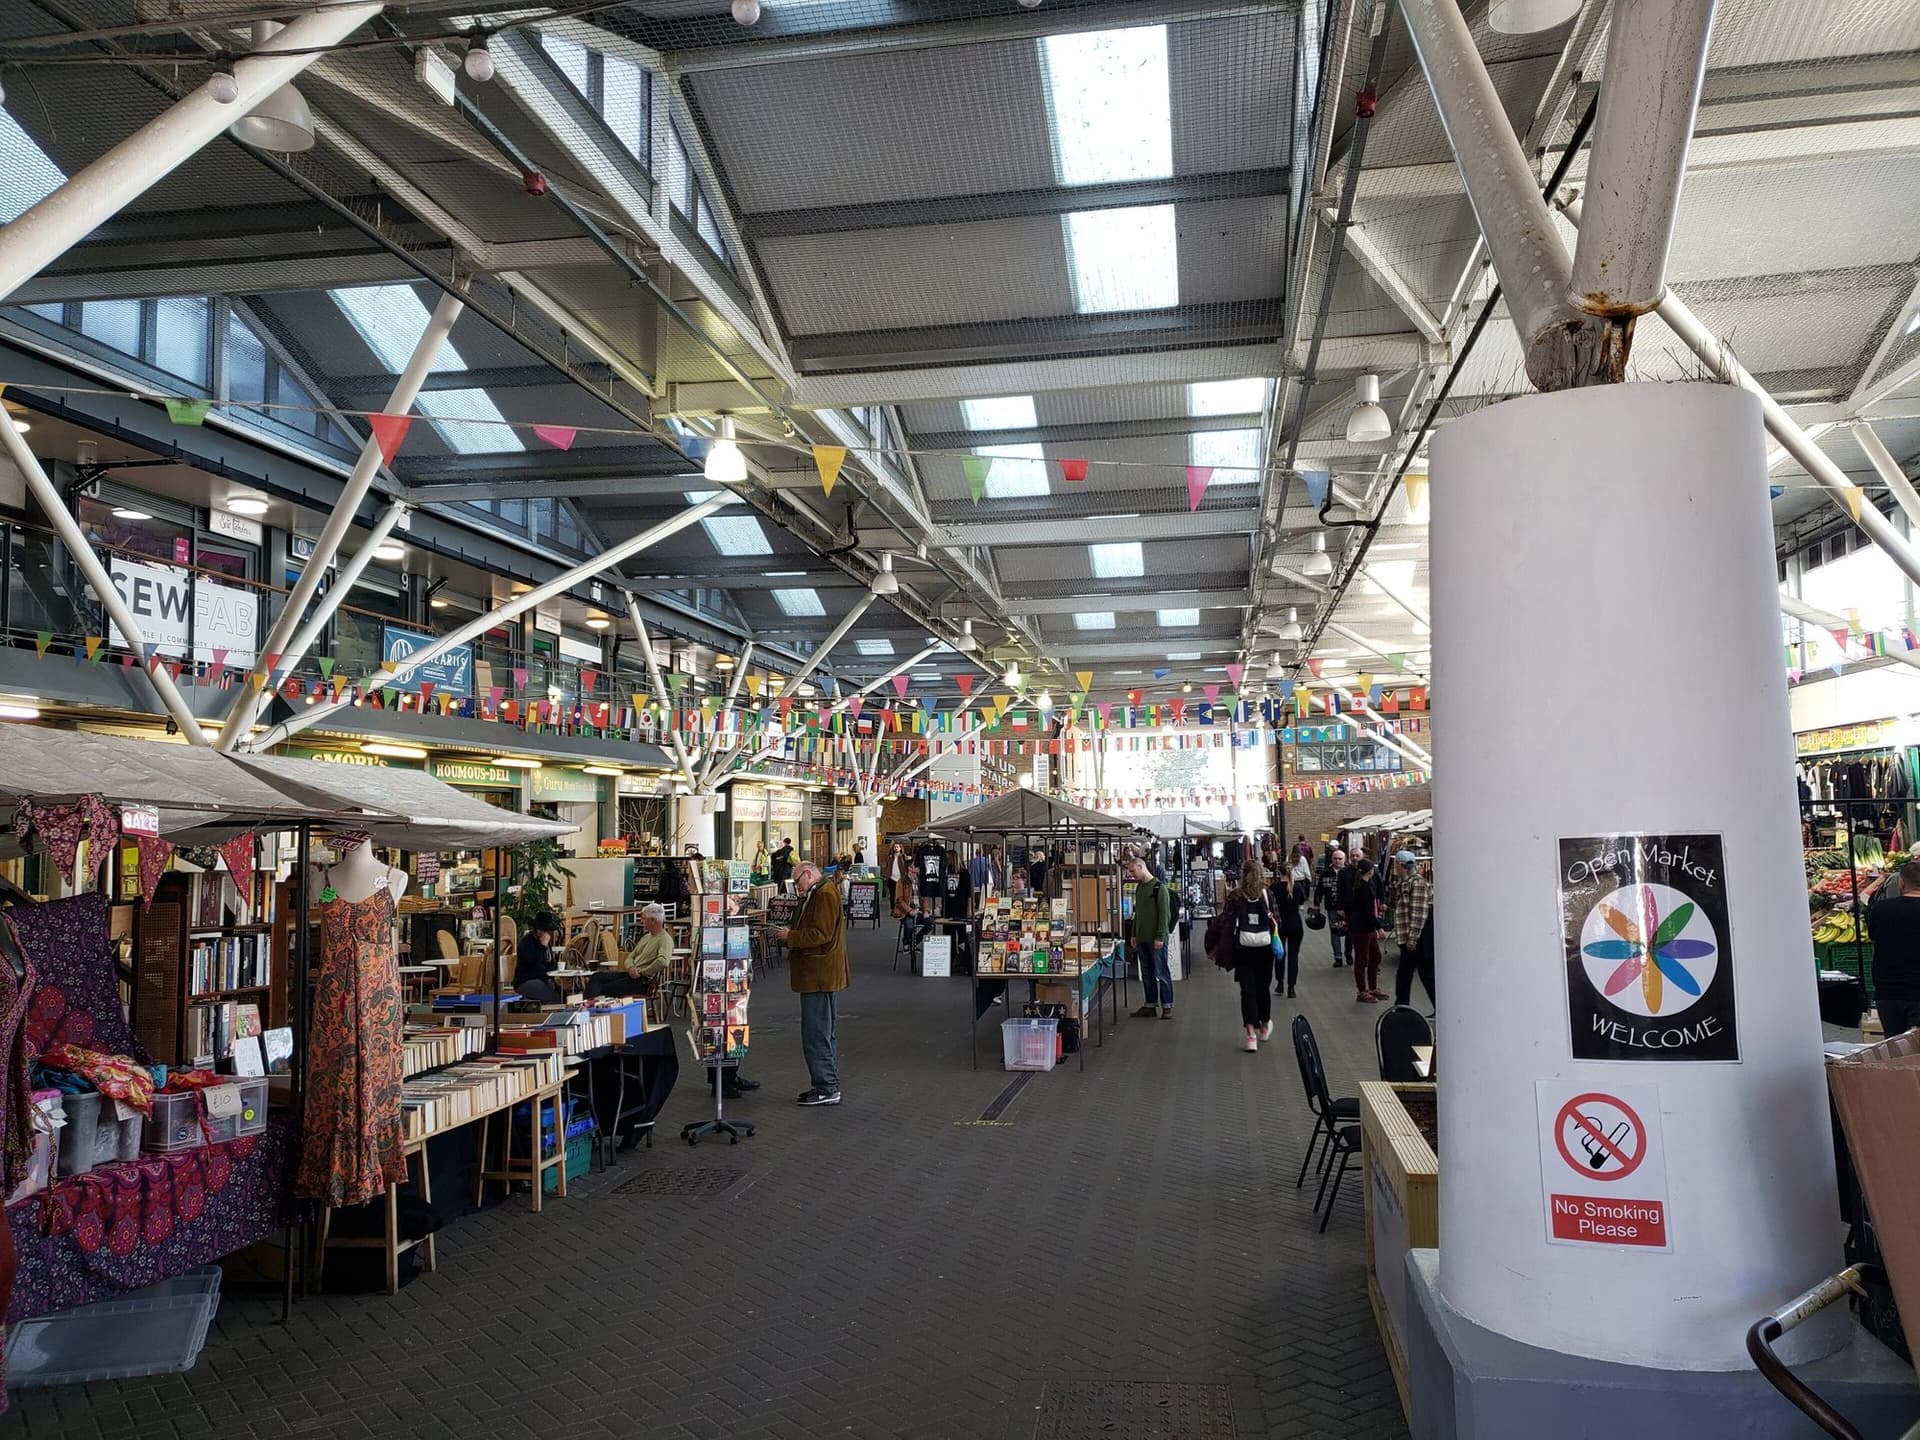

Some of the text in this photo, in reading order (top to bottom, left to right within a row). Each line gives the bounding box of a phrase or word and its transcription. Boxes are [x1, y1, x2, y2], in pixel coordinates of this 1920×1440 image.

[401, 572, 409, 591] 9
[110, 571, 189, 624] SEW
[436, 763, 511, 782] HOUMOUS-DELI
[999, 758, 1017, 776] UP
[331, 839, 358, 849] SALE
[338, 829, 374, 842] SALE
[1567, 844, 1717, 888] Open Market
[728, 969, 747, 978] FIRE
[1592, 1012, 1723, 1049] WELCOME
[1555, 1199, 1660, 1225] No Smoking
[1578, 1219, 1638, 1238] Please
